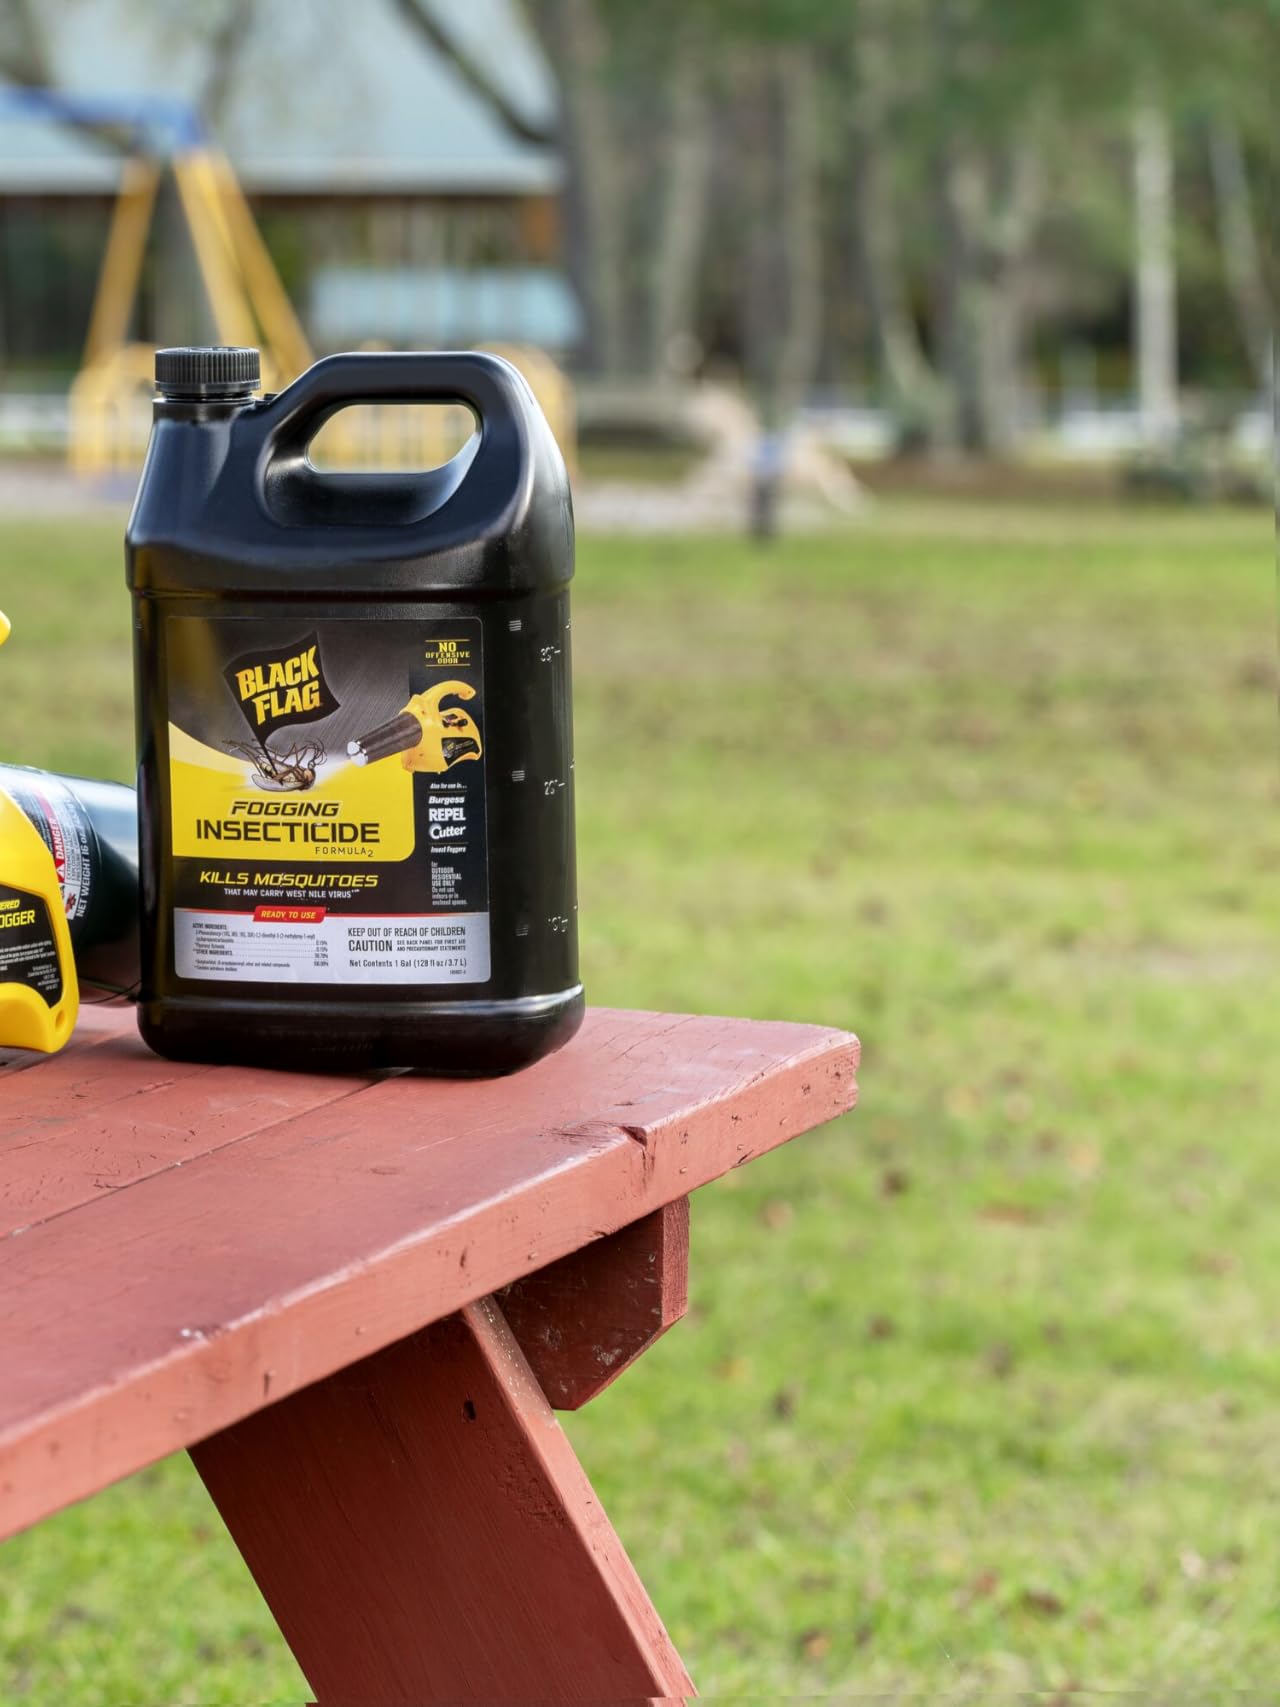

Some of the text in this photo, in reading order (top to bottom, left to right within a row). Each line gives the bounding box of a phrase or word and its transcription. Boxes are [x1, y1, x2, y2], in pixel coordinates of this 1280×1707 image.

[439, 642, 457, 652] NO
[425, 651, 470, 659] OFFENSIVE
[235, 645, 320, 701] BLACK
[251, 680, 320, 725] FLAG
[428, 796, 465, 805] Burgess
[231, 801, 339, 817] FOGGING
[428, 807, 466, 821] REPEL
[196, 819, 380, 843] INSECTICIDE
[429, 823, 466, 839] Cutter
[49, 818, 65, 860] DANGER
[81, 845, 90, 855] 16
[81, 857, 91, 896] WEIGHT
[200, 871, 379, 887] KILLS MOSQUITOES
[224, 887, 241, 896] THAT
[243, 888, 258, 897] MAY
[260, 889, 284, 897] CARRY
[286, 889, 306, 898] WEST
[309, 890, 326, 898] NILE
[76, 898, 87, 917] NET
[261, 910, 316, 919] READY TO USE
[348, 926, 466, 937] KEEP OUT OF REACH OF CHILDREN
[348, 939, 393, 952] CAUTION
[349, 959, 361, 967] Net
[363, 959, 393, 967] Contents
[400, 959, 411, 967] Gal
[413, 959, 429, 968] (128
[430, 959, 435, 967] fl
[460, 958, 467, 968] L)
